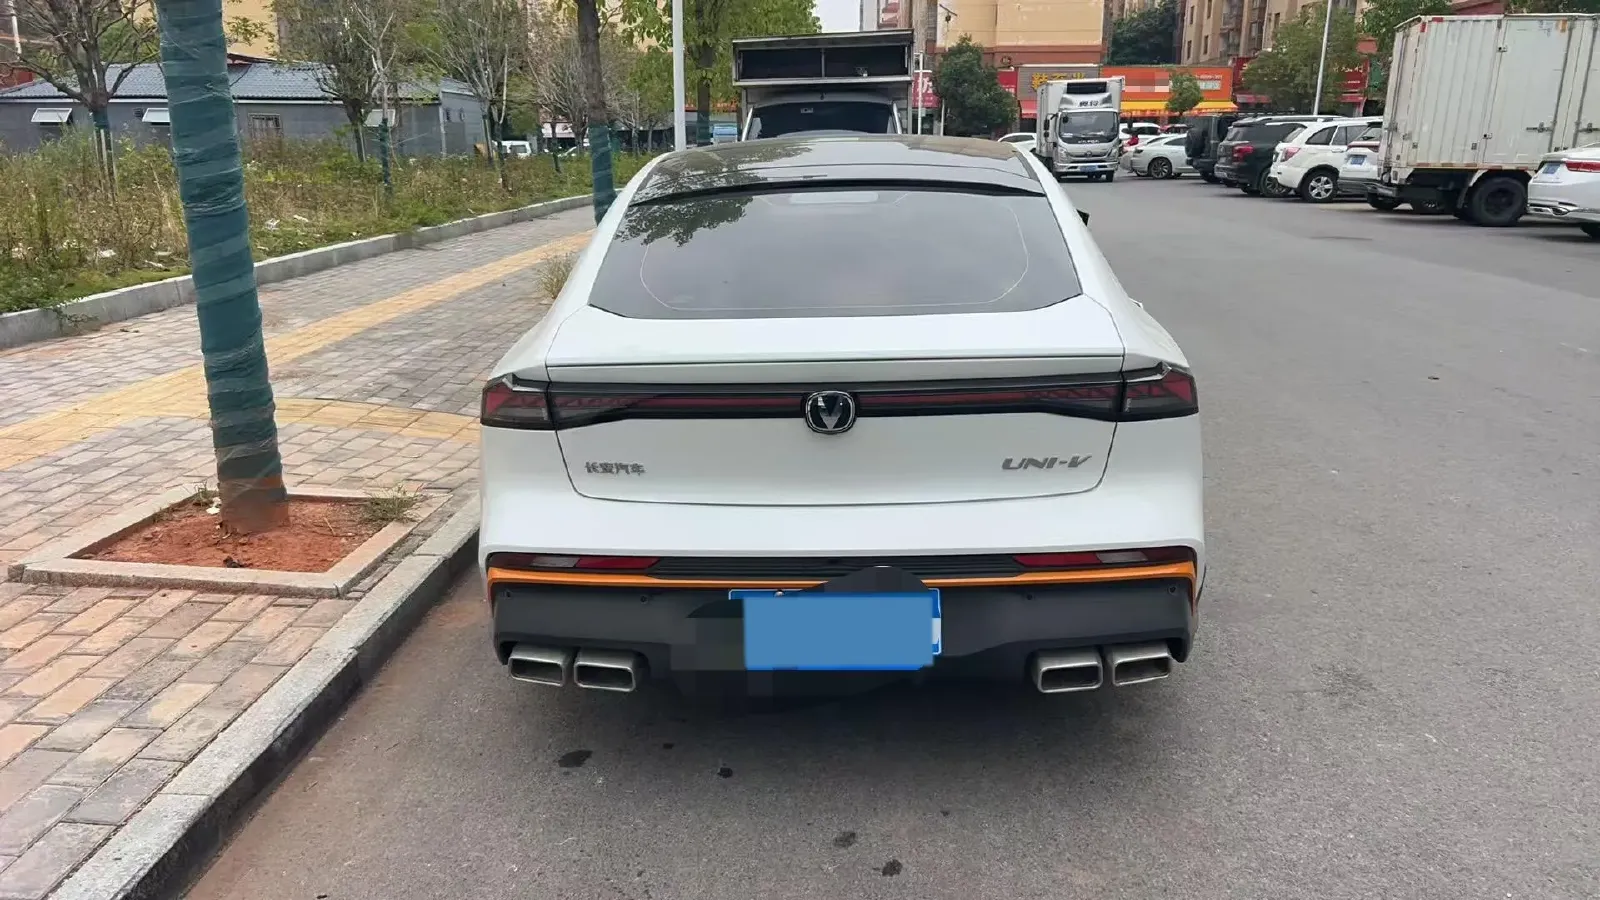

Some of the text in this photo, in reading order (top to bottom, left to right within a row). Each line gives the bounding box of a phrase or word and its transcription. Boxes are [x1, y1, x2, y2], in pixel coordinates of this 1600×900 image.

[584, 462, 646, 476] 长安汽车
[1002, 455, 1092, 470] UNI-V
